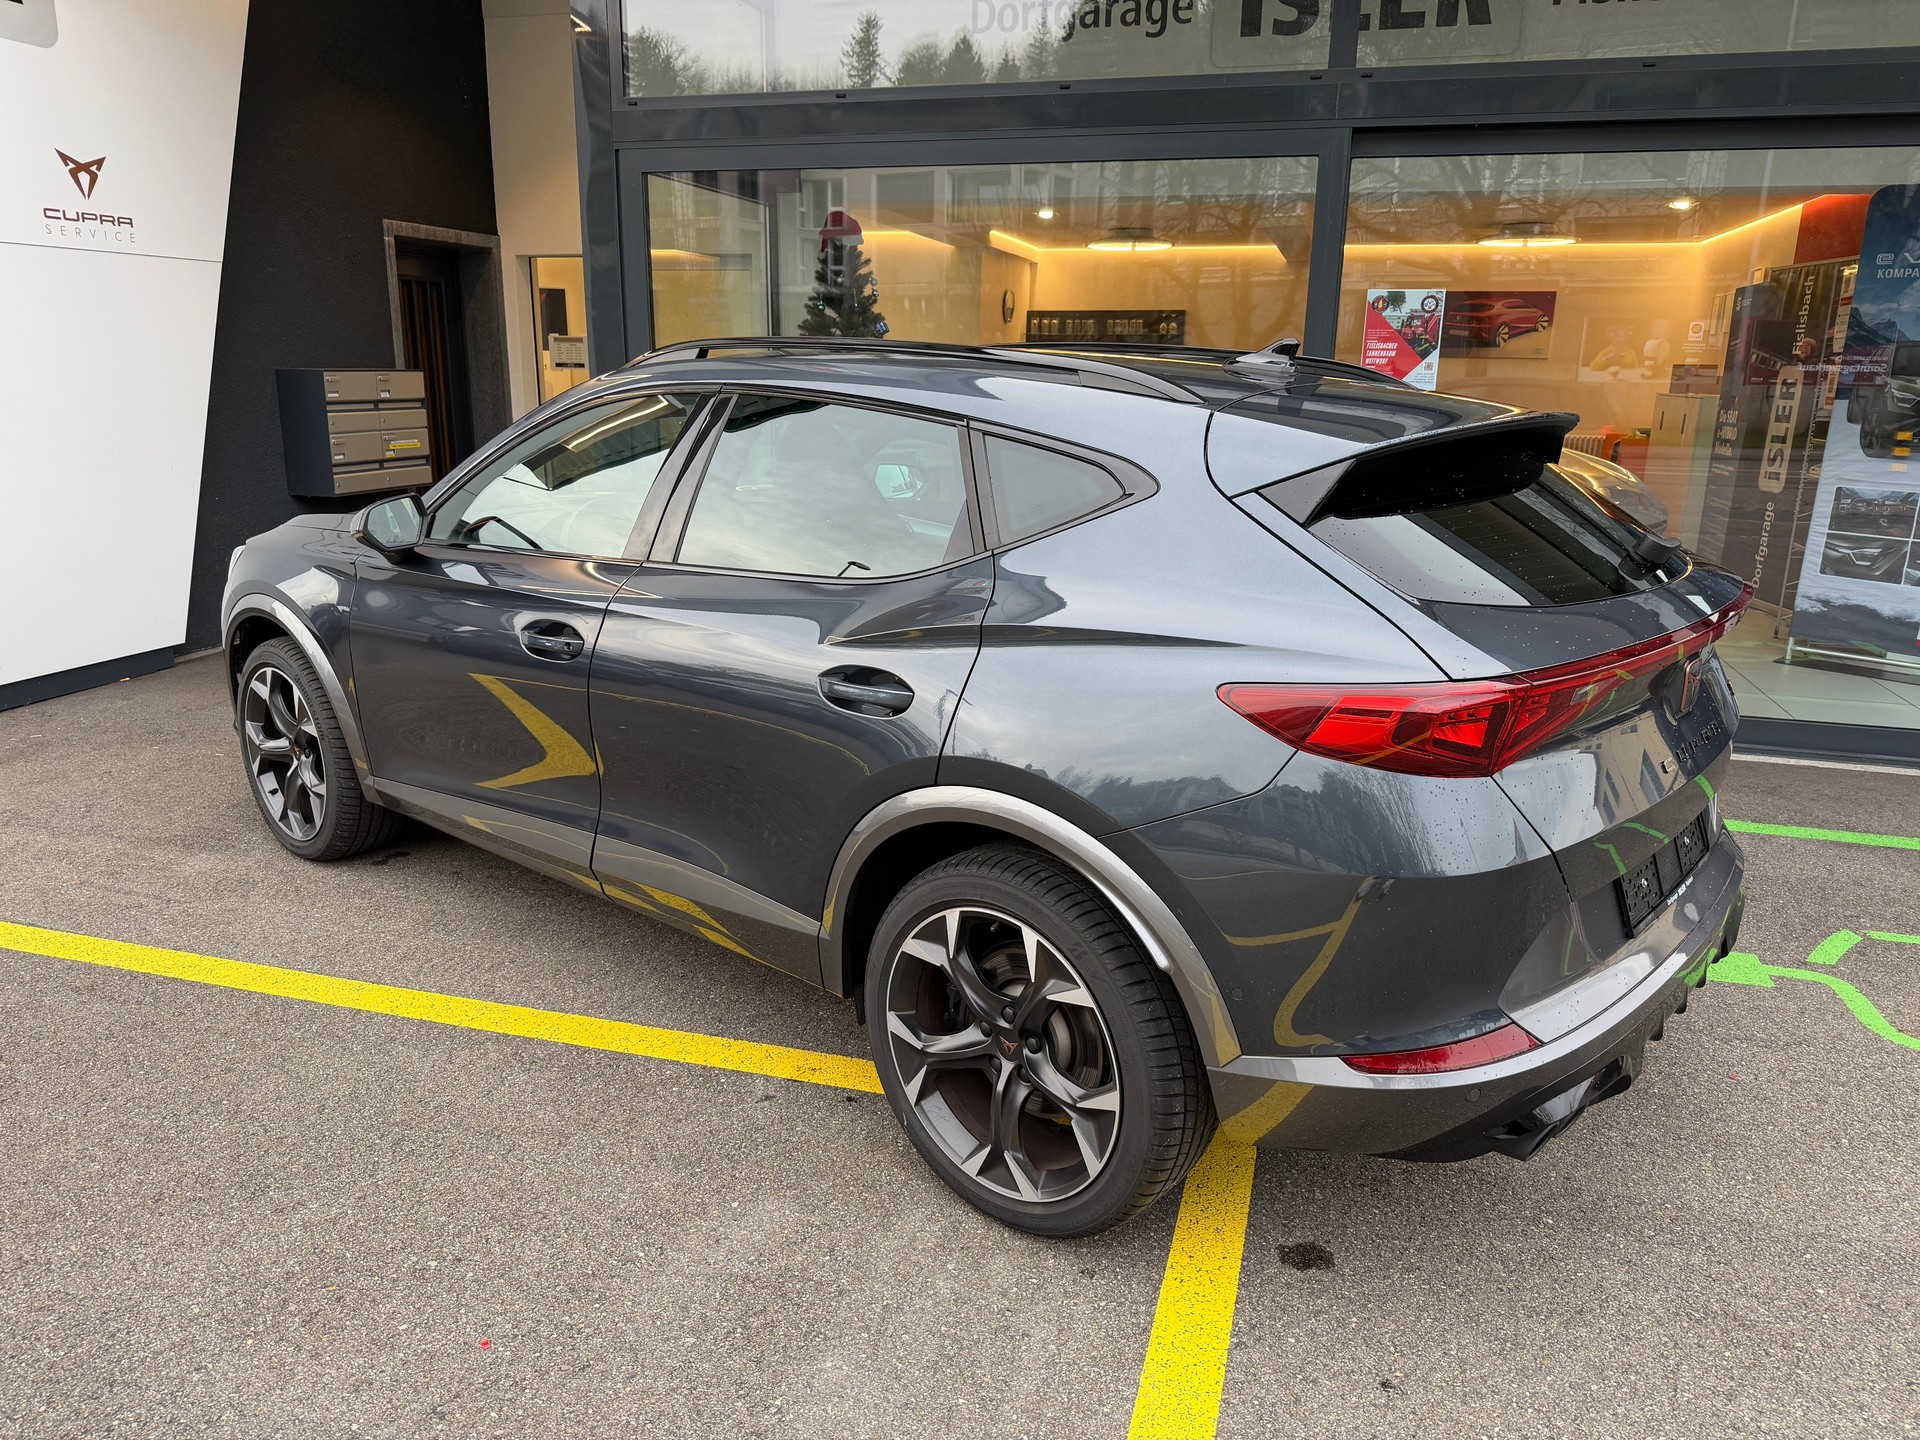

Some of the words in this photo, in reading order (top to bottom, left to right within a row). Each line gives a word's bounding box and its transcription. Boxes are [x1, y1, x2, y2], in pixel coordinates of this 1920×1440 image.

[43, 207, 134, 229] CUPRA
[45, 224, 136, 243] SERVICE
[1751, 501, 1775, 589] Dorfgarage
[1792, 275, 1815, 355] Fislisbach
